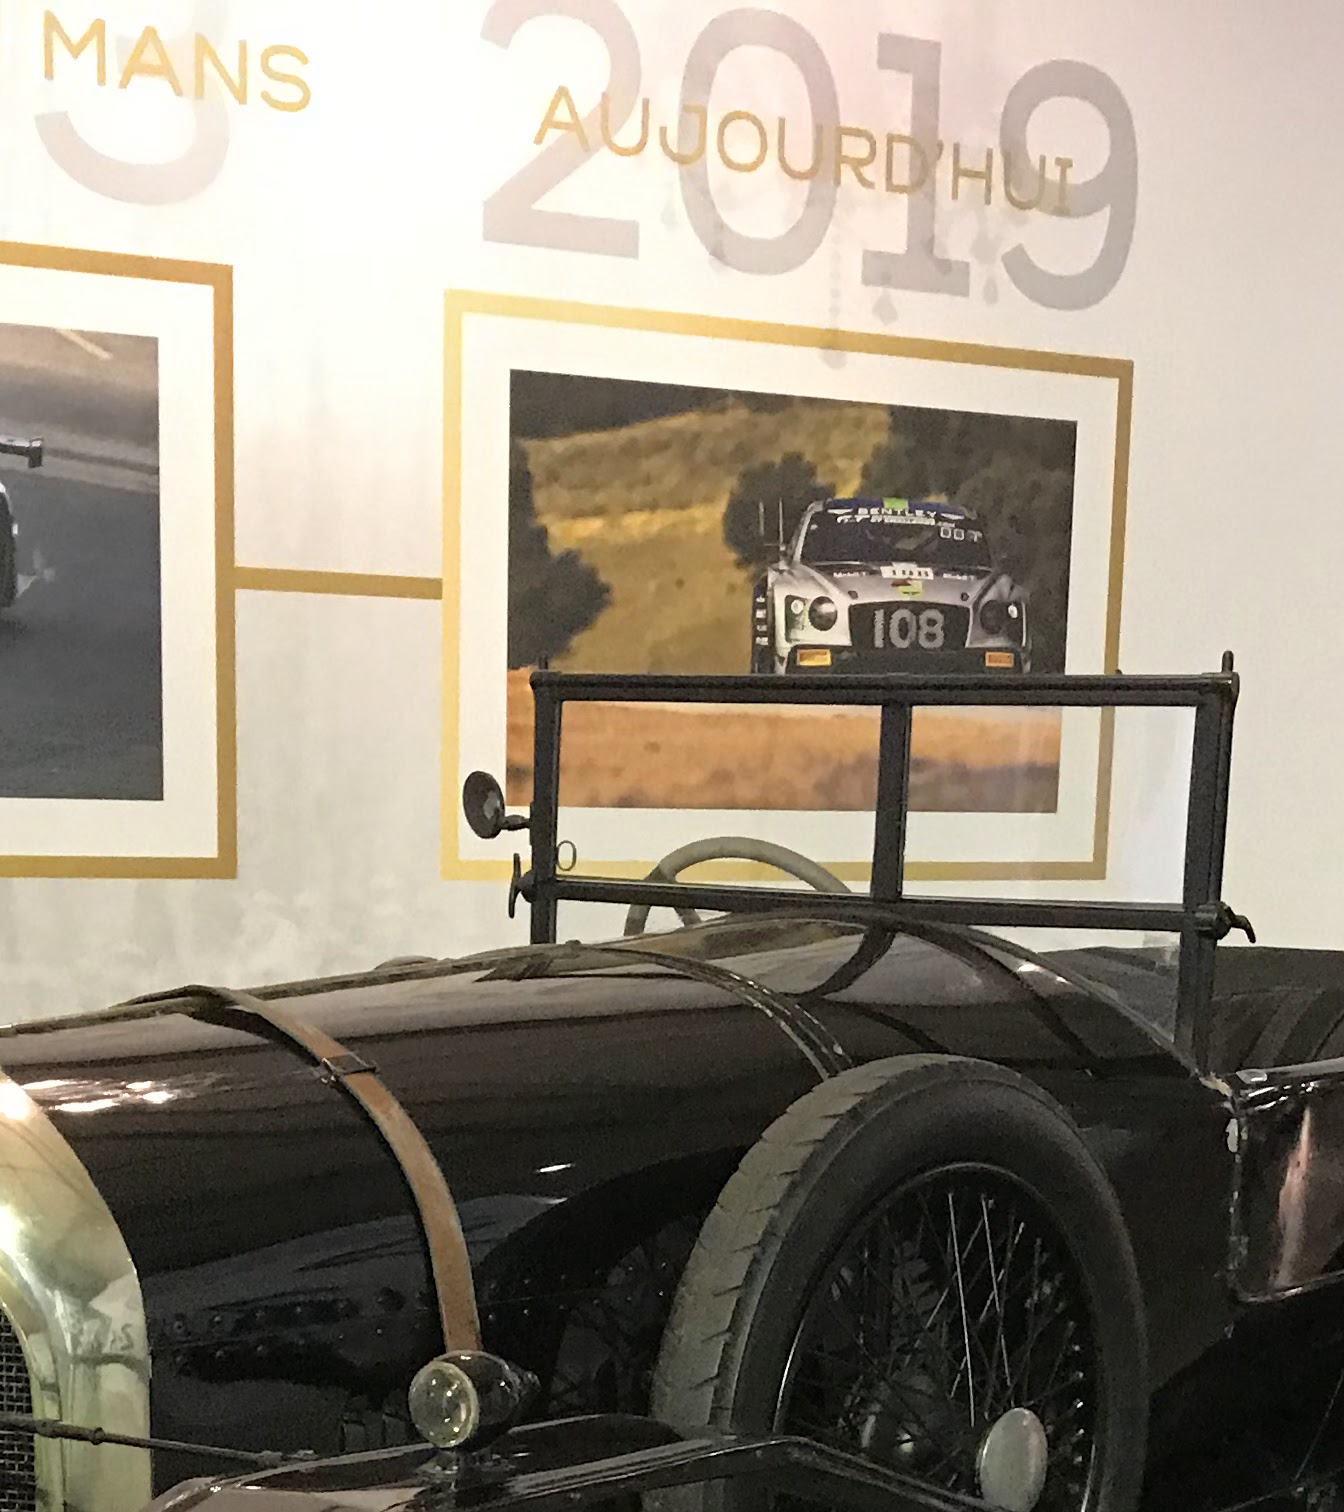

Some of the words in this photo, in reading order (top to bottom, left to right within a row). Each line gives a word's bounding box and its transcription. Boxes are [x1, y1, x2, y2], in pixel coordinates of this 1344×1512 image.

[40, 12, 314, 113] MANS
[479, 0, 1138, 311] 2019
[533, 84, 1074, 216] AUJOURD'HUI
[873, 608, 946, 650] 108
